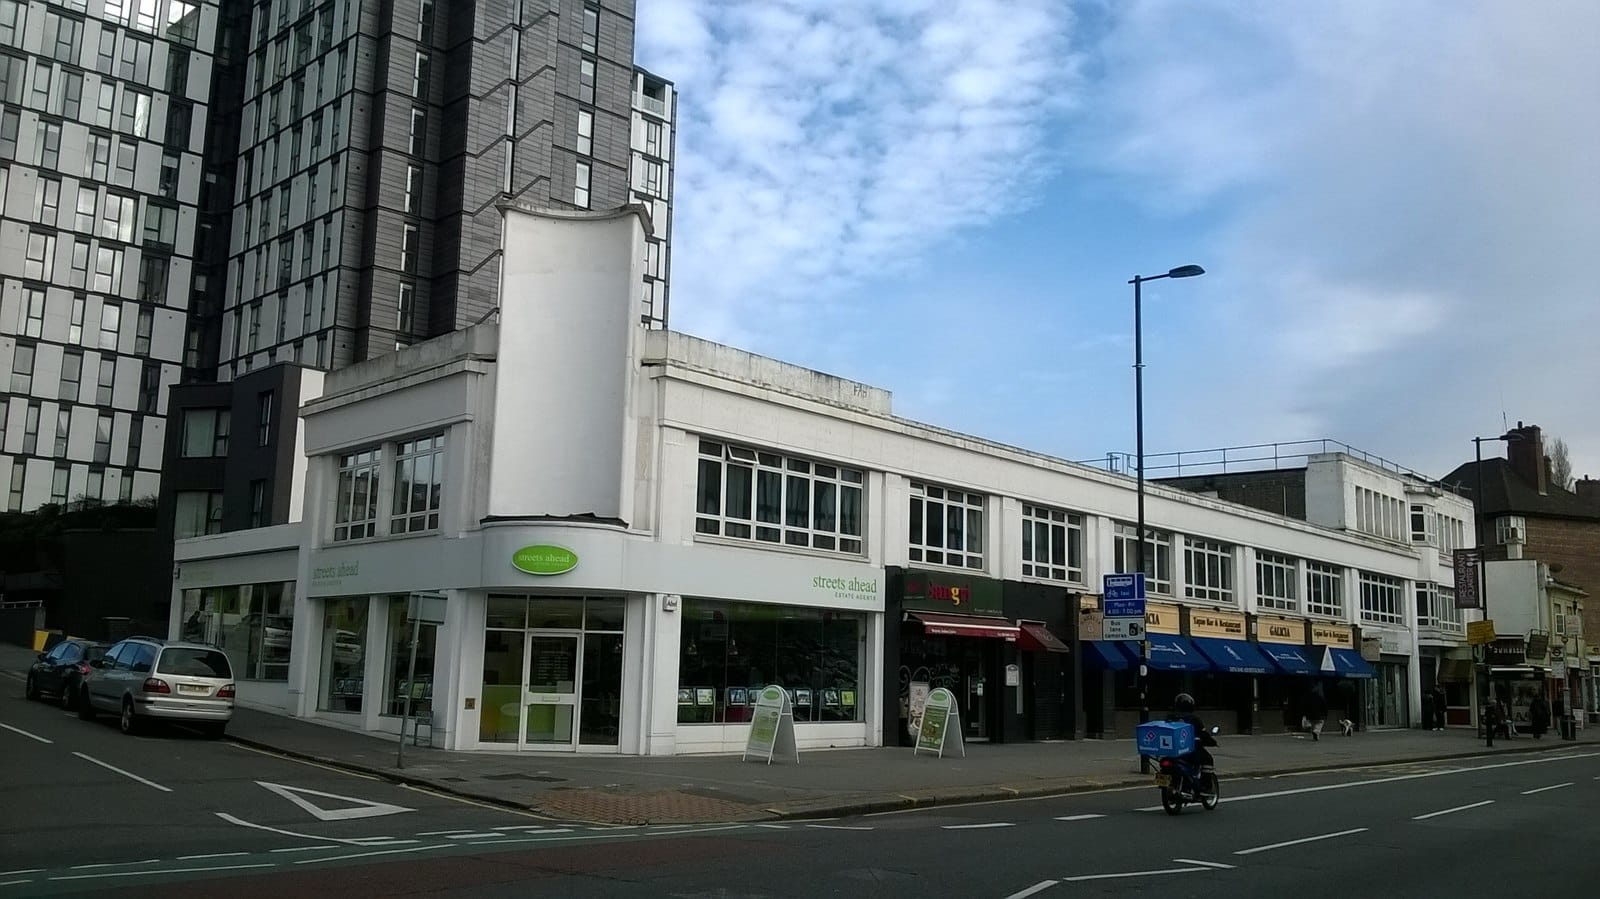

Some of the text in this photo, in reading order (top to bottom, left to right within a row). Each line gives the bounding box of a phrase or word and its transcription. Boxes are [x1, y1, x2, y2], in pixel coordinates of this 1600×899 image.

[546, 553, 570, 563] ahead
[812, 575, 877, 594] streets ahead
[835, 592, 854, 600] ESTATE
[1269, 625, 1291, 638] GALICIA
[1163, 738, 1169, 747] L
